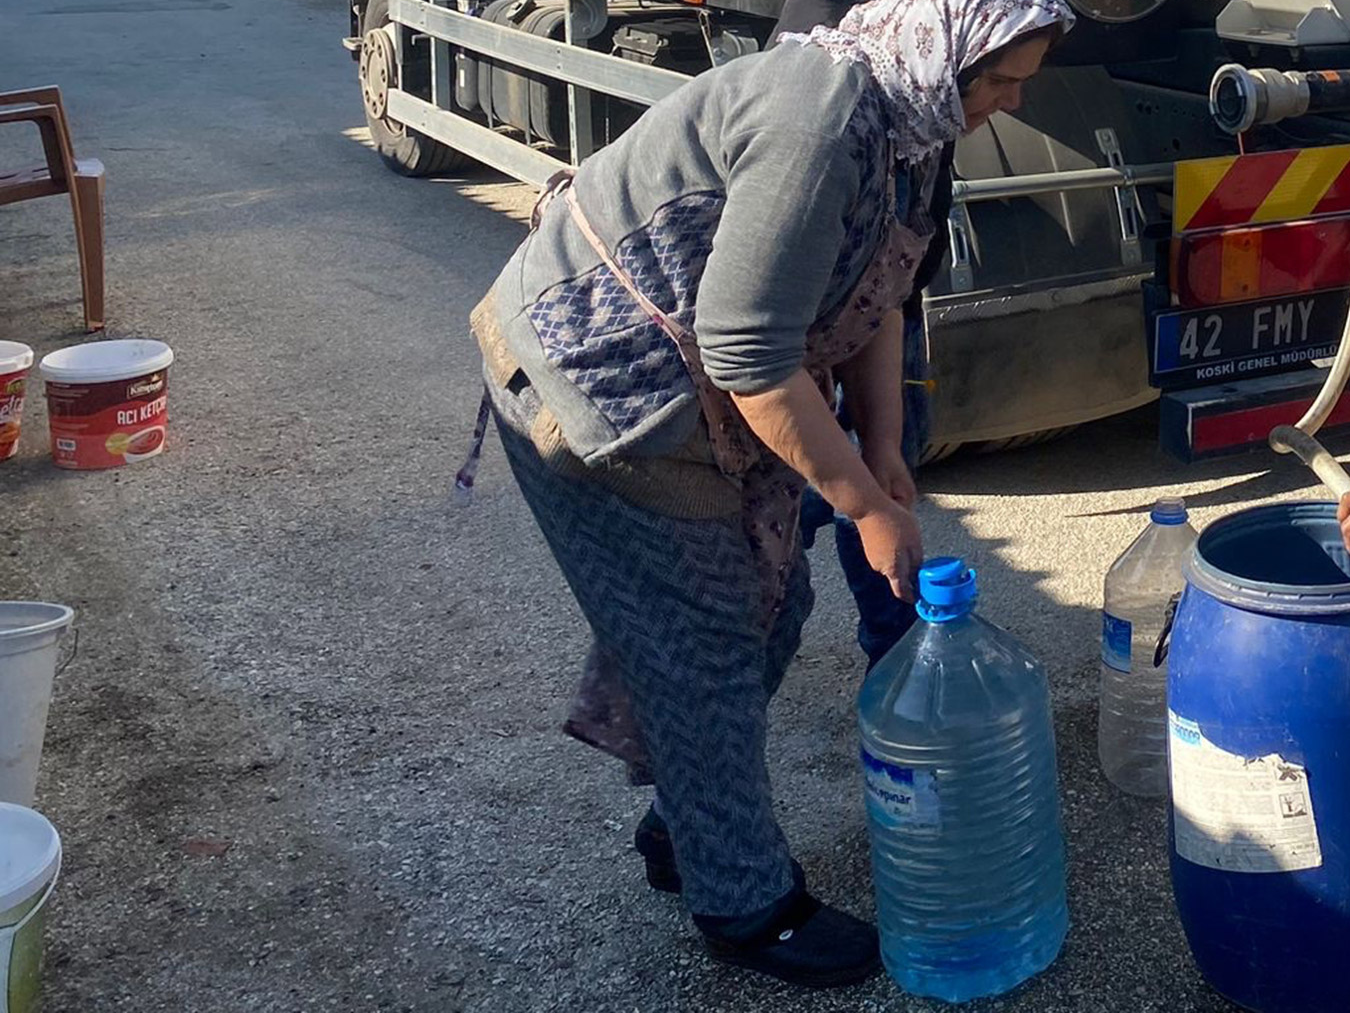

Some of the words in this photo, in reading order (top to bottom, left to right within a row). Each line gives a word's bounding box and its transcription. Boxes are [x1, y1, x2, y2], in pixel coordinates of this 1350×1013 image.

[1179, 314, 1223, 360] 42
[1252, 299, 1315, 350] FMY
[1196, 361, 1235, 379] KOSKİ
[1238, 356, 1278, 372] GENEL
[1280, 345, 1338, 365] MÜDÜRLÜ
[117, 410, 138, 425] ACI
